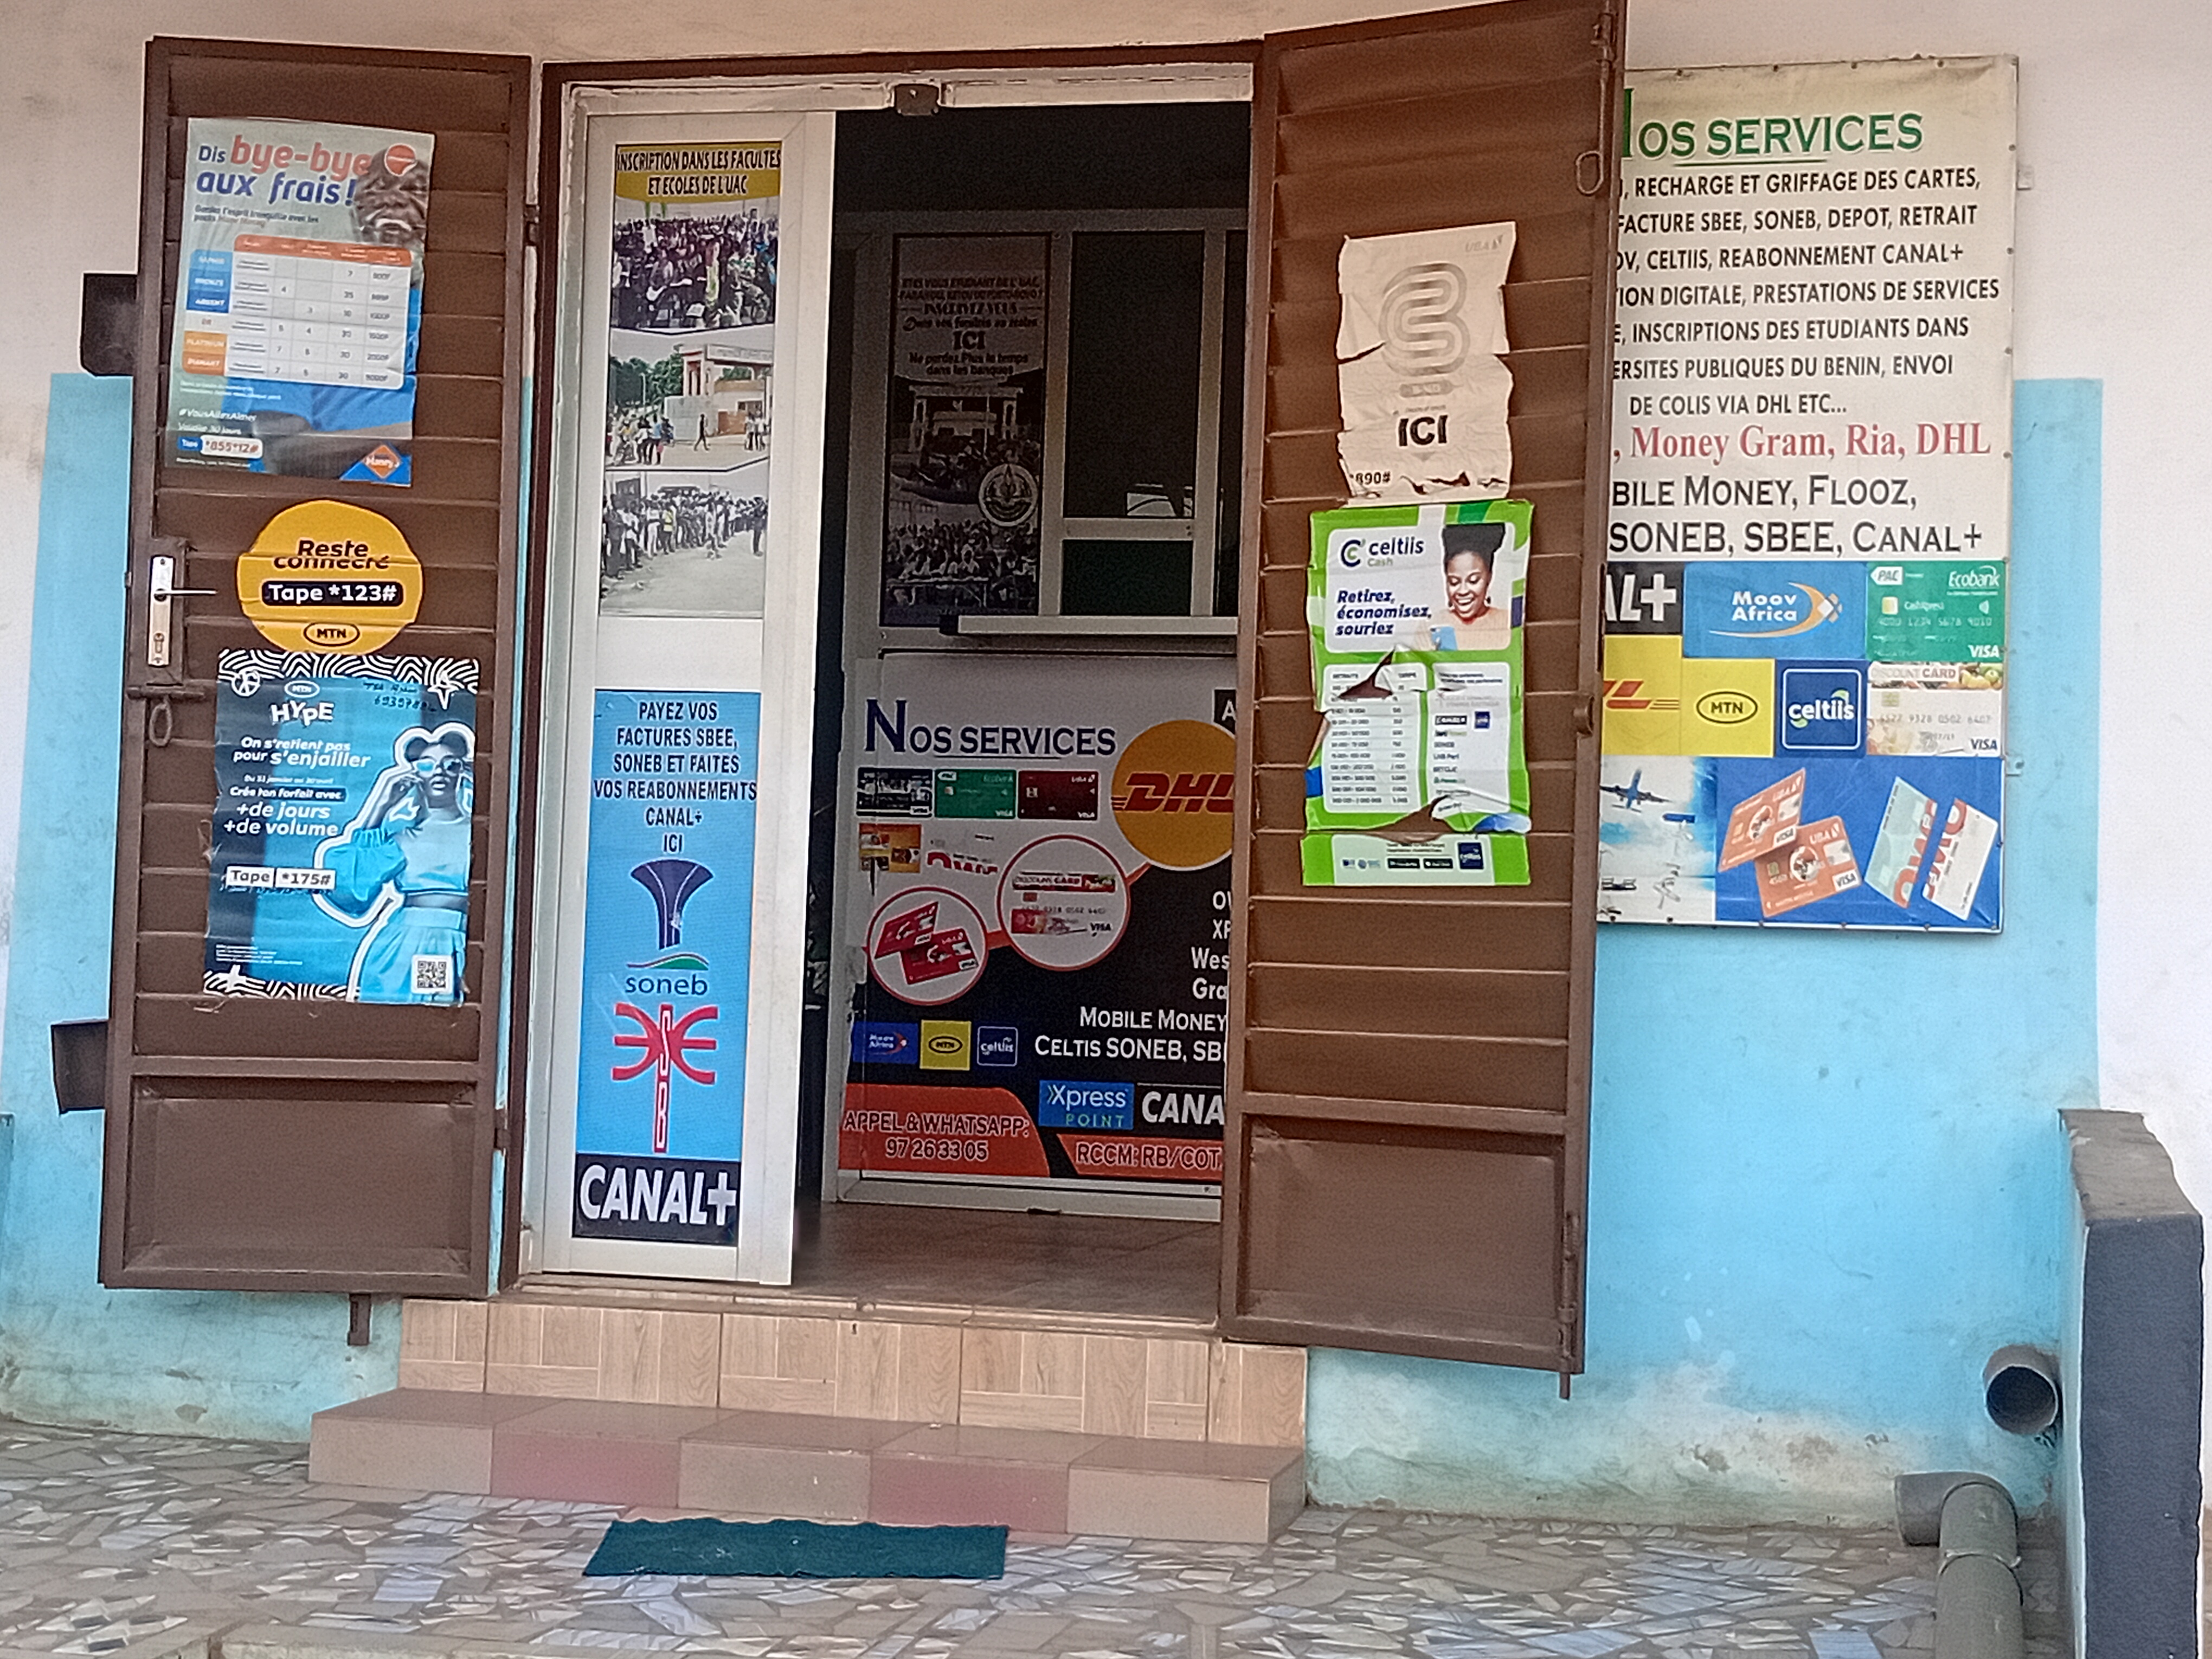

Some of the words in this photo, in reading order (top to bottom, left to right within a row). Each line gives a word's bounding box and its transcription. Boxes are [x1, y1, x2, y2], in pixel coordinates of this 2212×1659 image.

[1623, 88, 1695, 159] OS
[1706, 112, 1923, 156] SERVICES
[197, 145, 226, 163] Dis
[230, 134, 371, 182] bye-bye
[617, 151, 678, 171] INSCRIPTION
[681, 151, 709, 170] DANS
[711, 150, 728, 169] LES
[731, 149, 781, 169] FACULTES
[196, 171, 256, 196] aux
[648, 177, 661, 195] ET
[663, 176, 699, 195] ECOLES
[702, 175, 715, 194] DE
[718, 175, 747, 194] L'UAC
[1635, 174, 1734, 197] RECHARGE
[1740, 174, 1760, 194] ET
[1766, 171, 1857, 194] GRIFFAGE
[1864, 170, 1898, 190] DES
[1905, 166, 1981, 190] CARTES,
[1700, 211, 1747, 234] SBEE,
[1754, 209, 1822, 233] SONEB,
[1829, 208, 1892, 230] DEPOT,
[1900, 205, 1978, 227] RETRAIT
[1616, 251, 1640, 273] OV,
[1647, 249, 1713, 272] CELTIIS,
[1719, 245, 1876, 268] REABONNEMENT
[1882, 243, 1964, 264] CANAL+
[1616, 287, 1654, 307] ION
[1660, 285, 1746, 307] DIGITALE,
[1753, 281, 1876, 304] PRESTATIONS
[1883, 281, 1907, 301] DE
[1913, 279, 1999, 301] SERVICES
[953, 331, 985, 350] ICI
[1633, 321, 1760, 343] INSCRIPTIONS
[1766, 319, 1799, 341] DES
[1806, 317, 1910, 339] ETUDIANTS
[1917, 316, 1969, 338] DANS
[1613, 360, 1679, 379] ERSITES
[1686, 358, 1785, 380] PUBLIQUES
[1791, 357, 1817, 377] DU
[1824, 355, 1886, 379] BENIN,
[1893, 355, 1953, 376] ENVOI
[1630, 396, 1652, 415] DE
[1659, 395, 1711, 415] COLIS
[1717, 395, 1750, 415] VIA
[1756, 394, 1793, 415] DHL
[1798, 393, 1847, 414] ETC...
[1398, 415, 1448, 446] ICI
[1631, 427, 1729, 466] Money
[1739, 424, 1836, 460] Gram,
[1847, 423, 1906, 460] Ria,
[1917, 422, 1991, 455] DHL
[1612, 481, 1674, 506] BILE
[1683, 475, 1798, 510] MONEY,
[297, 539, 368, 557] Reste
[1609, 522, 1734, 557] SONEB,
[1744, 522, 1843, 557] SBEE,
[1853, 522, 1982, 552] CANAL+
[1948, 570, 2000, 587] Ecobank
[268, 584, 323, 605] Tape
[1732, 591, 1796, 606] Moov
[1732, 606, 1797, 622] Africa
[316, 628, 346, 639] MTN
[1334, 621, 1394, 636] souriez
[1967, 645, 1999, 658] VISA
[1922, 668, 1956, 678] CARD
[639, 702, 684, 720] PAYEZ
[689, 702, 717, 721] VOS
[1711, 702, 1744, 715] MTN
[241, 737, 261, 748] On
[325, 742, 351, 754] pas
[617, 728, 691, 747] FACTURES
[696, 728, 737, 750] SBEE,
[959, 727, 1116, 756] SERVICES
[1971, 739, 1997, 750] VISA
[234, 751, 267, 763] pour
[613, 754, 661, 773] SONEB
[667, 755, 685, 772] ET
[690, 755, 740, 773] FAITES
[594, 780, 621, 799] VOS
[627, 781, 757, 800] REABONNEMENTS
[1123, 772, 1234, 814] DHL
[277, 802, 330, 820] jours
[646, 807, 702, 827] CANAL+
[264, 820, 339, 837] volume
[663, 834, 683, 852] ICI
[230, 870, 271, 883] Tape
[1212, 919, 1231, 940] XP
[1191, 947, 1229, 970] Wes
[625, 976, 708, 995] soneb
[1193, 978, 1229, 1000] Gra
[1080, 1007, 1152, 1030] MOBILE
[1106, 1038, 1188, 1063] SONEB,
[1192, 1039, 1225, 1062] SB
[1052, 1084, 1127, 1109] Xpress
[1142, 1091, 1224, 1126] CANA
[844, 1110, 903, 1132] APPEL
[906, 1113, 919, 1133] &
[923, 1114, 1030, 1137] WHATSAPP:
[1066, 1114, 1123, 1127] POINT
[1076, 1143, 1137, 1167] RCCM:
[1141, 1144, 1222, 1170] RB/COT
[580, 1165, 736, 1226] CANAL+
